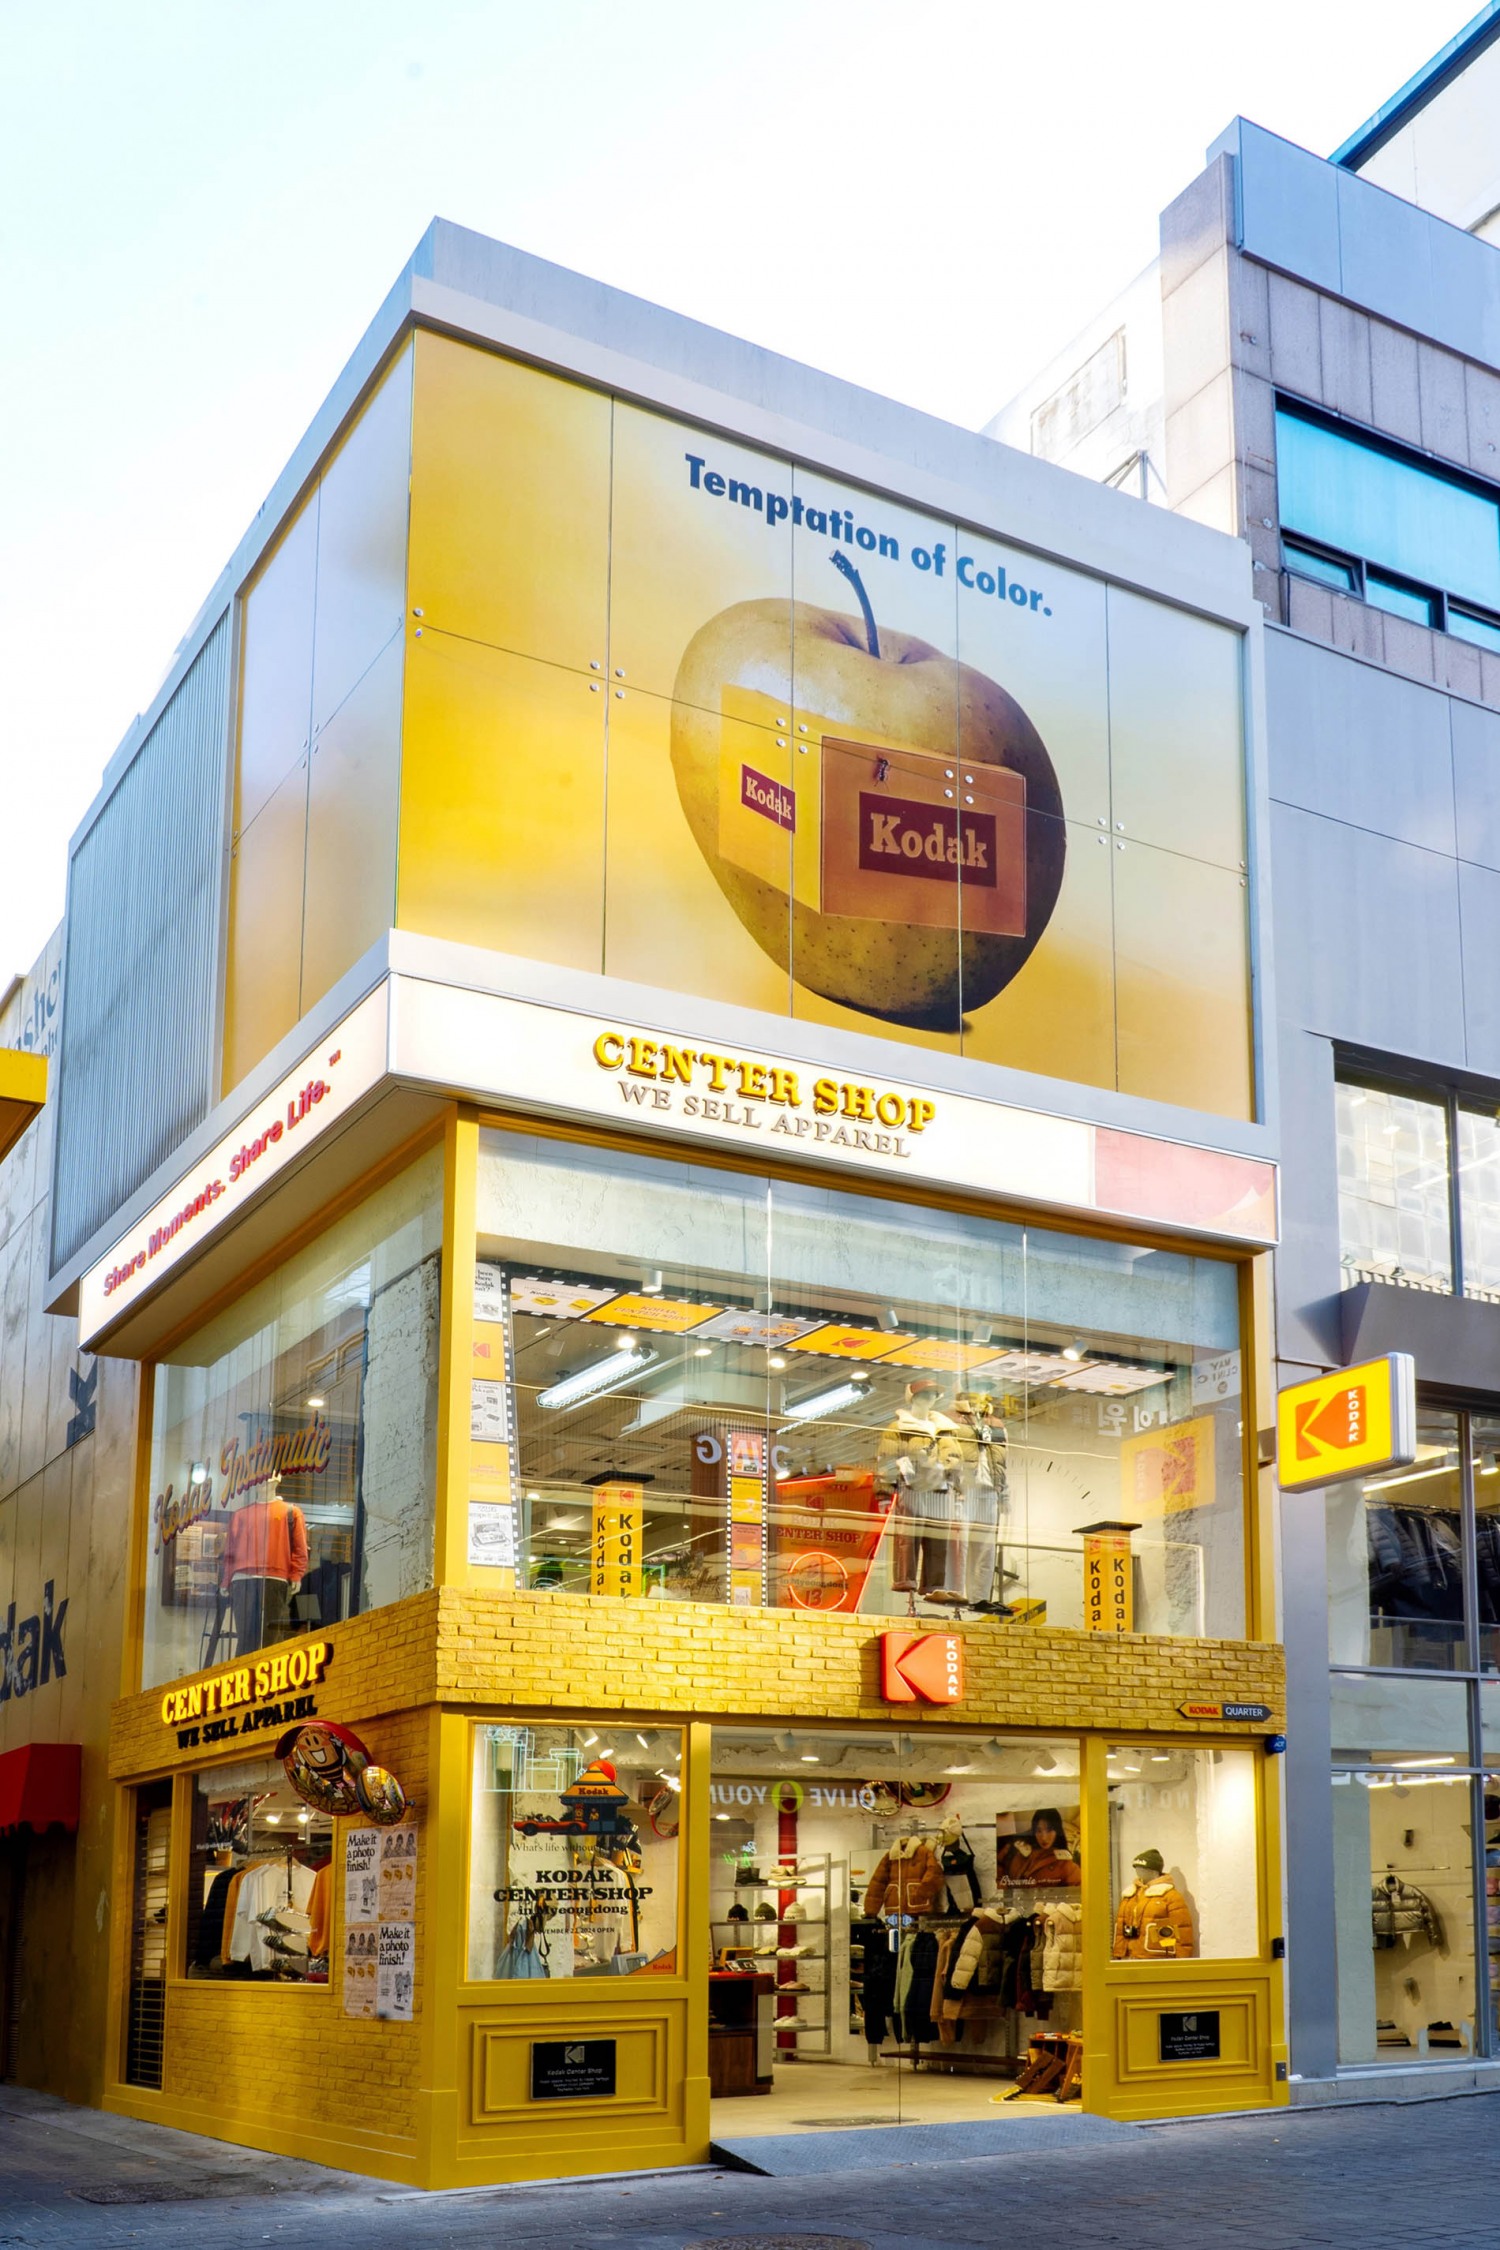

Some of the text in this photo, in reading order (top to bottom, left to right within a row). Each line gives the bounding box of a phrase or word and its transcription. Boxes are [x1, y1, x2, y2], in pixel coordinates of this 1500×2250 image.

[685, 453, 1053, 617] Temptation of Color.
[745, 776, 792, 821] Kodak
[869, 812, 988, 868] Kodak
[593, 1032, 936, 1135] CENTER SHOP
[617, 1080, 912, 1158] WE SELL APPAREL
[103, 1250, 146, 1297] Share
[147, 1179, 226, 1260] Moments.
[229, 1120, 283, 1183] Share
[286, 1079, 331, 1130] Life.
[1347, 1389, 1360, 1443] KODAK
[220, 1409, 333, 1509] Instamatic
[826, 1531, 861, 1544] SHOP
[596, 1514, 606, 1597] Koda
[1089, 1559, 1102, 1632] Koda
[946, 1639, 960, 1696] KODAK
[162, 1642, 328, 1725] CENTER SHOP
[1189, 1705, 1263, 1717] KODAK QUARTER
[177, 1694, 319, 1750] WE SELL APPAREL
[578, 1787, 609, 1795] Kodak
[347, 1833, 377, 1848] Make it
[511, 1842, 544, 1852] What's
[545, 1841, 560, 1852] life
[347, 1846, 375, 1861] a photo
[346, 1857, 371, 1873] finish!
[536, 1870, 613, 1883] KODAK
[494, 1886, 654, 1902] CENTER SHOP
[519, 1903, 629, 1916] in Myeongdong
[379, 1926, 410, 1940] Make it
[597, 1927, 615, 1935] OPEN
[379, 1939, 409, 1954] a photo
[378, 1952, 405, 1966] finish!
